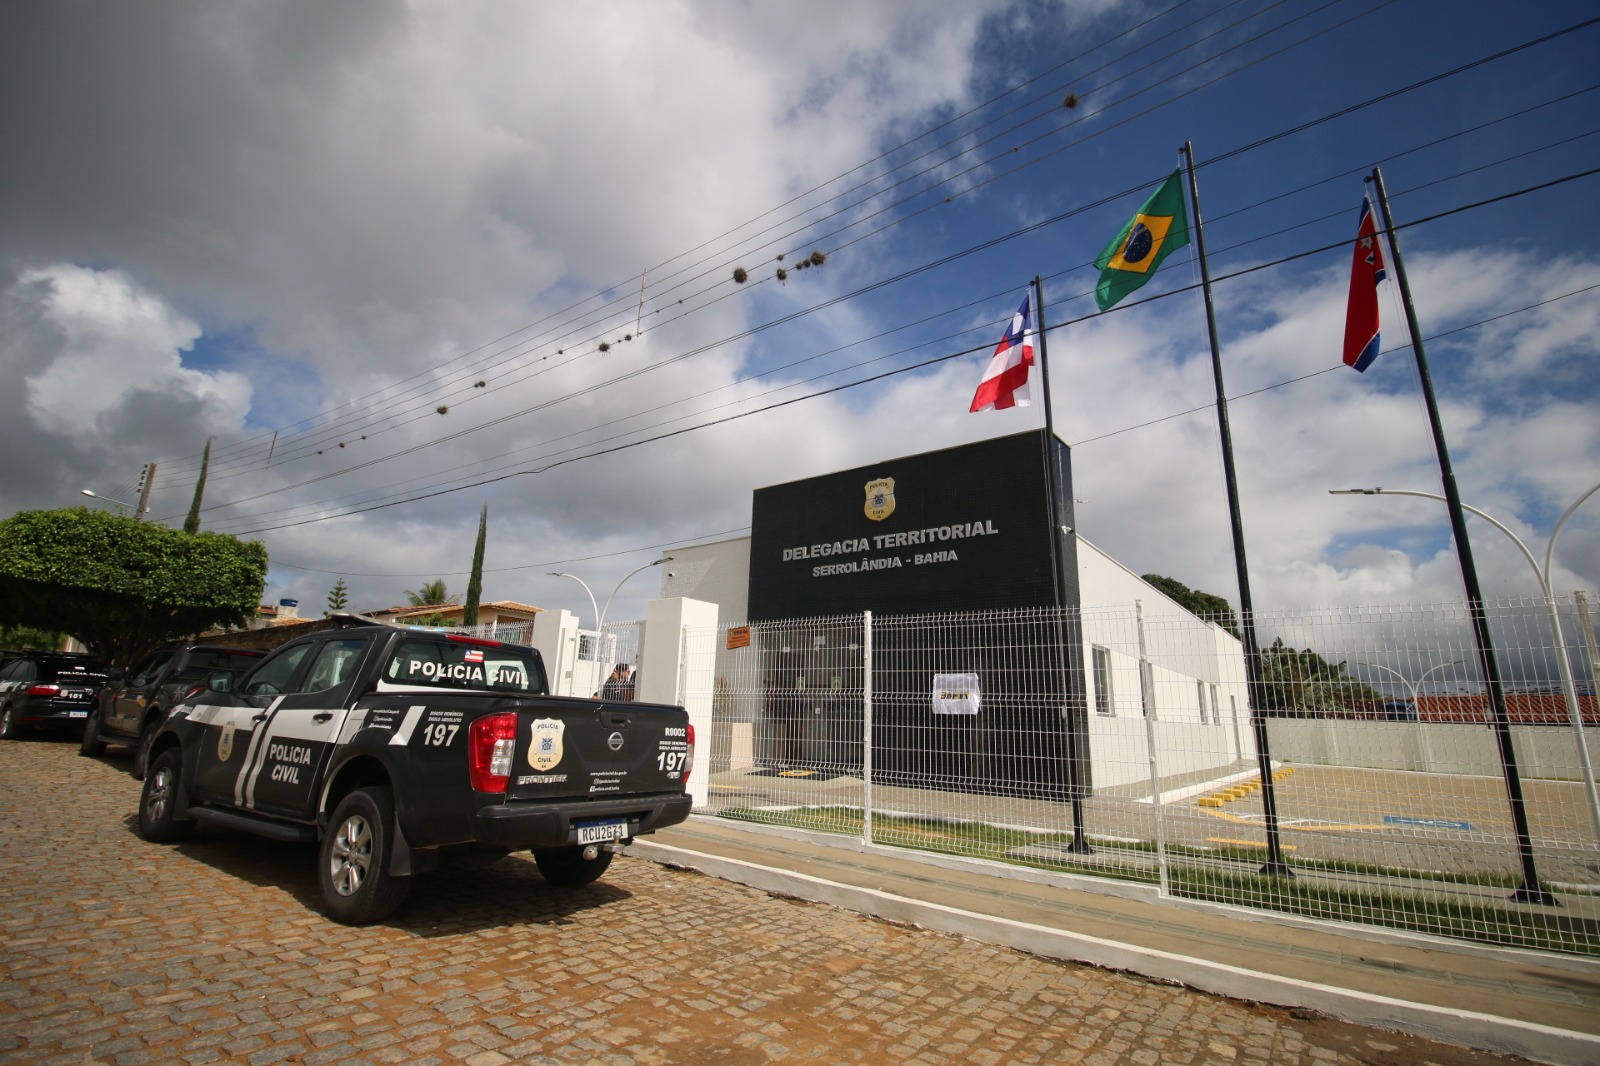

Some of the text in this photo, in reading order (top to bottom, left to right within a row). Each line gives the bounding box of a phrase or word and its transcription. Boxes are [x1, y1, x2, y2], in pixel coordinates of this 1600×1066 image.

[783, 520, 998, 561] DELEGACIA TERRITORIAL
[812, 557, 902, 577] SERROLÂNDIA
[915, 550, 958, 565] BAHIA
[409, 660, 529, 685] POLÍCIA CIVIL
[423, 723, 460, 747] 197
[664, 727, 686, 737] R0002
[657, 751, 687, 771] 197
[271, 764, 299, 785] CIVIL
[516, 774, 568, 785] FRONTIER
